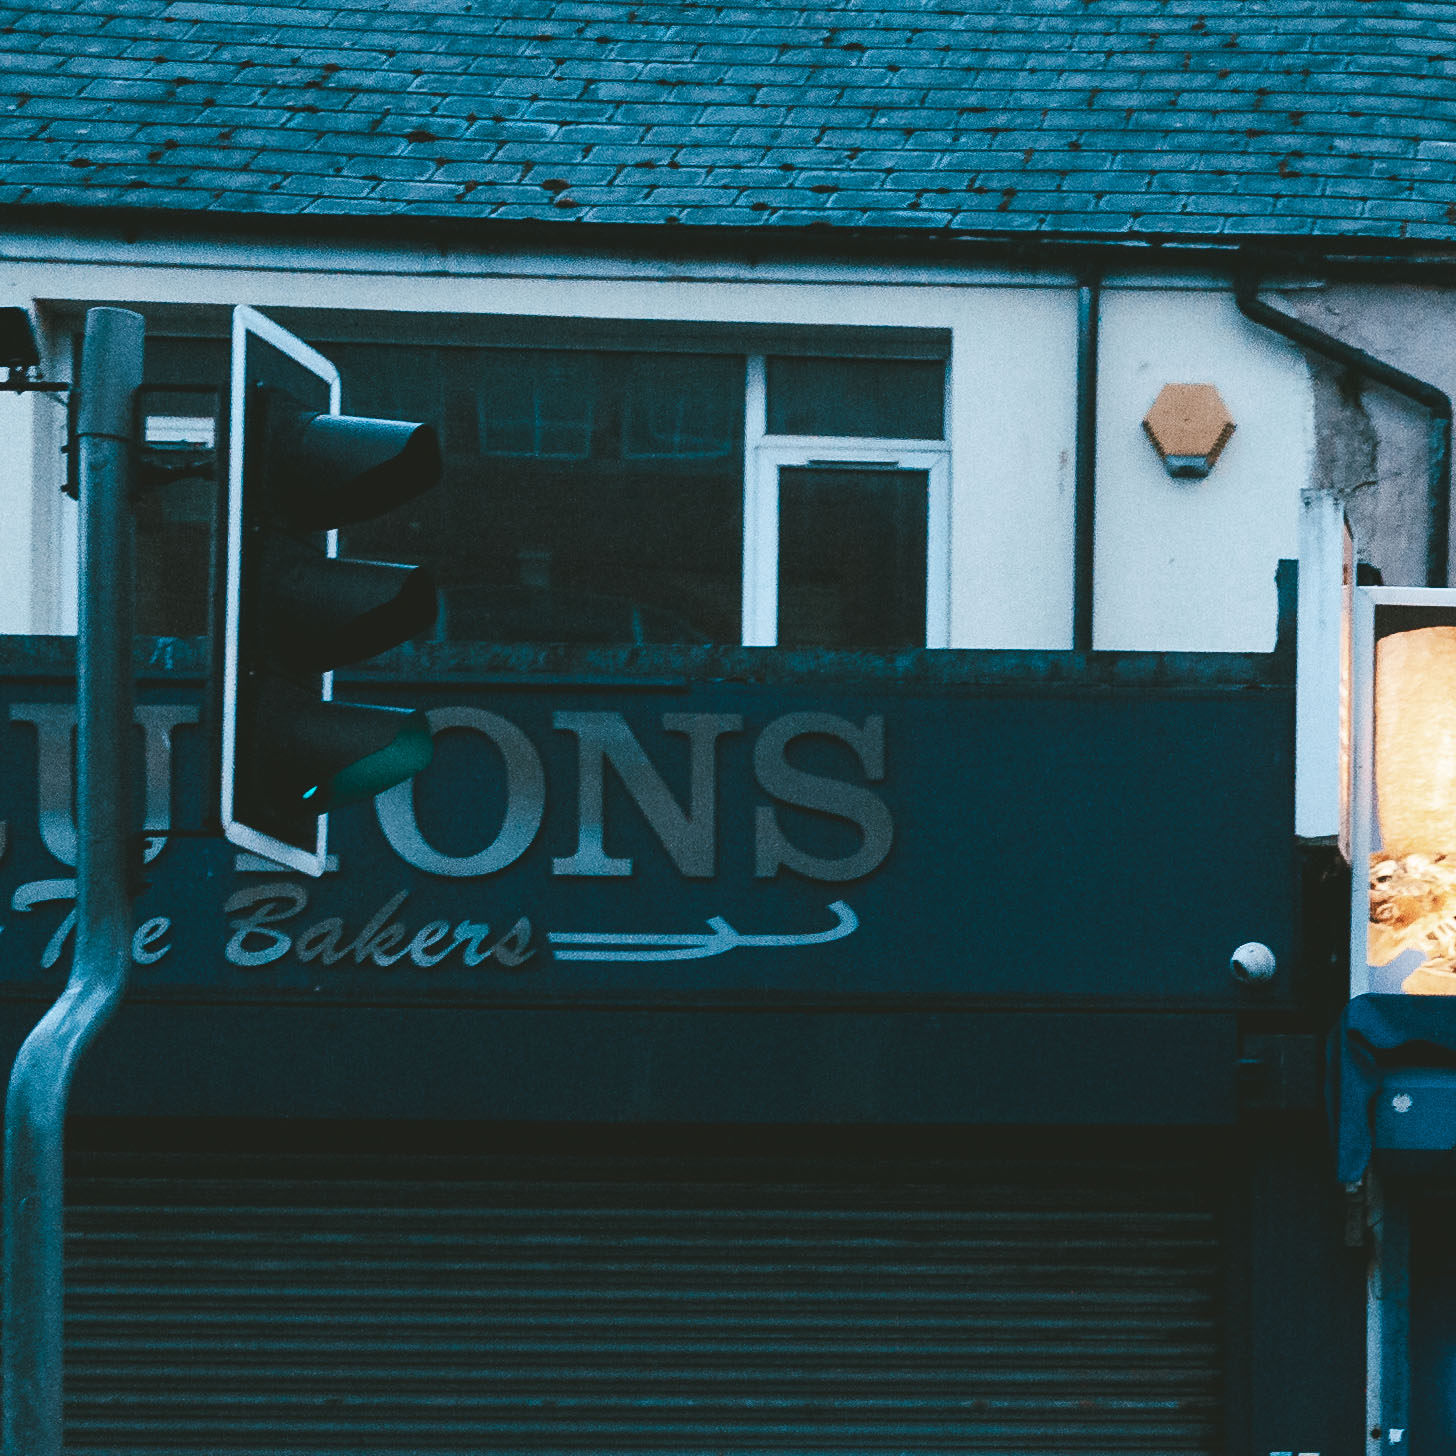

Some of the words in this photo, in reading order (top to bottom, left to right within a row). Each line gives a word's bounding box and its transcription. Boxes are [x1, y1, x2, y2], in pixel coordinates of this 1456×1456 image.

[0, 702, 895, 882] UONS
[11, 878, 172, 968] Te
[223, 881, 537, 968] Bakers
